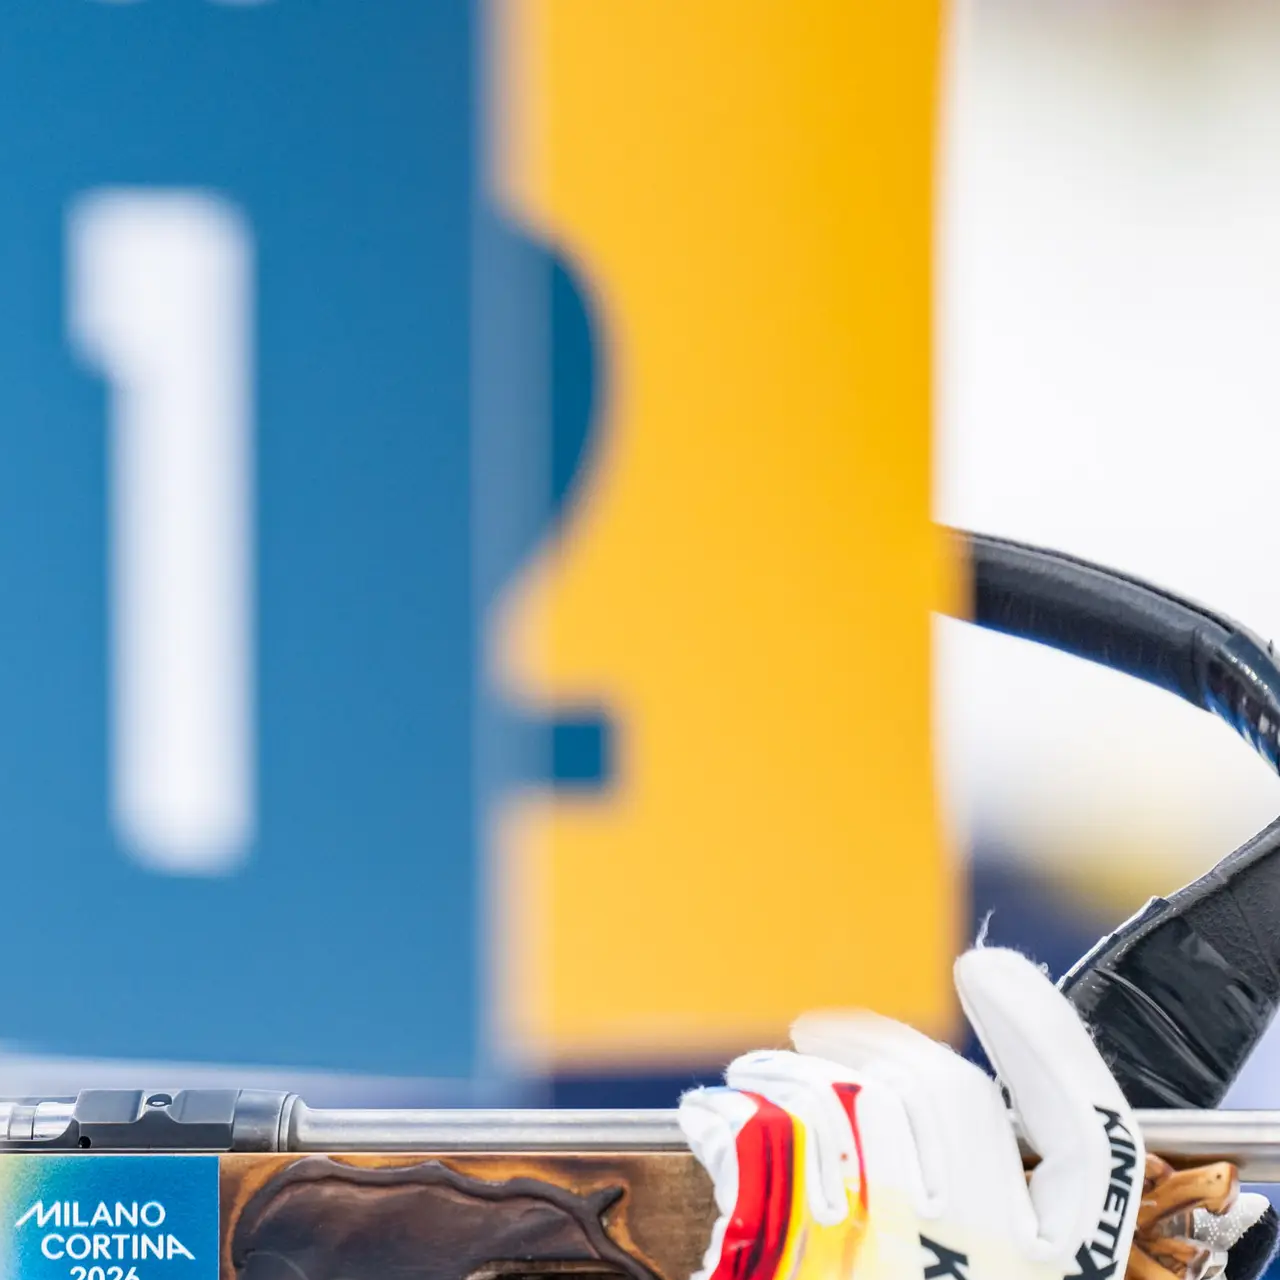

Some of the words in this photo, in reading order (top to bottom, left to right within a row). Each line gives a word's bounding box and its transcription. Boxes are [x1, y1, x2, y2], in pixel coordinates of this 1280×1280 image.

[65, 177, 257, 878] 1
[14, 1201, 166, 1229] MILANO
[40, 1233, 196, 1261] CORTINA
